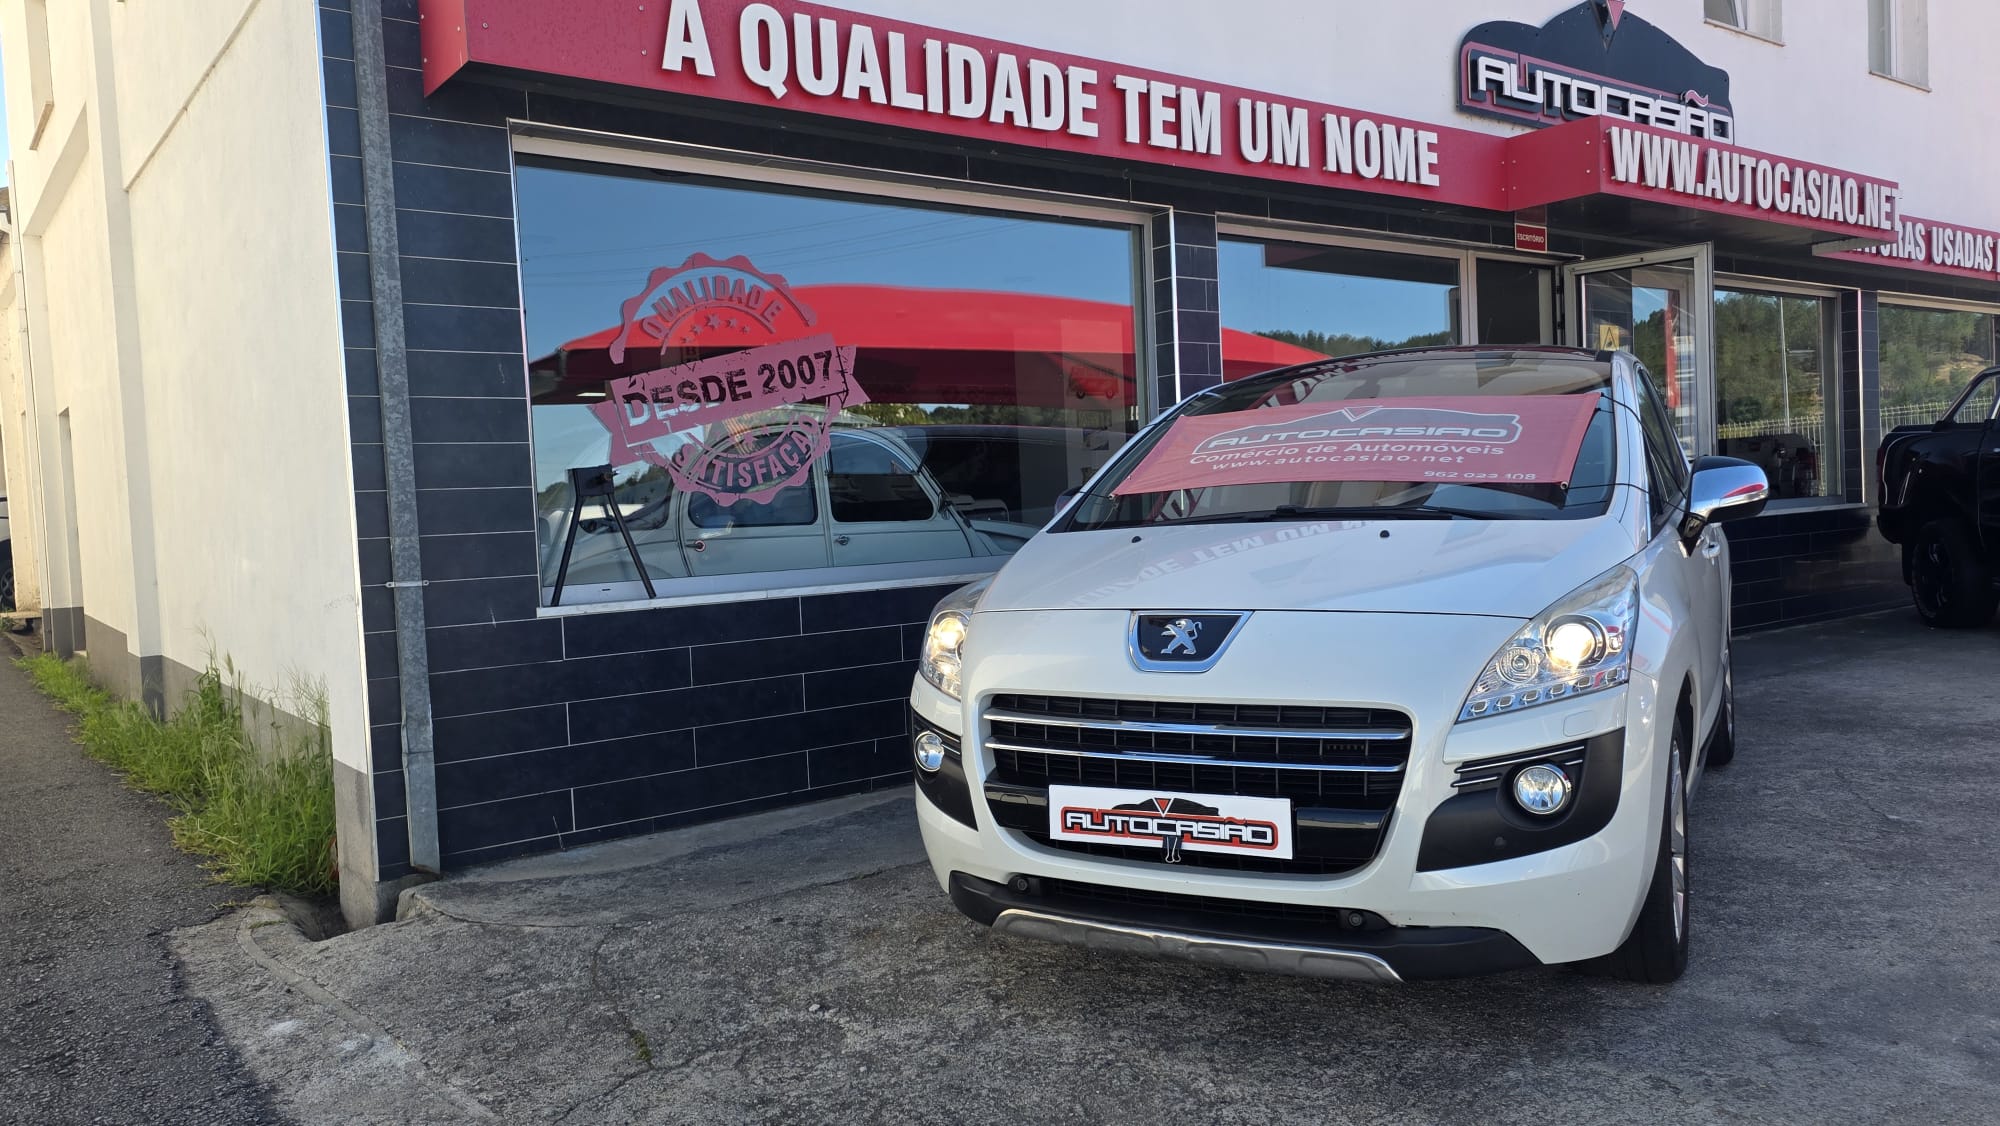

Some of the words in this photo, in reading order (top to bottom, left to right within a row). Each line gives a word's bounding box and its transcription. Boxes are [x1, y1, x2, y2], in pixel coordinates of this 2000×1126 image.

[661, 0, 715, 76] A
[740, 2, 1098, 138] QUALIDADE
[1116, 75, 1222, 156] TEM
[1238, 98, 1309, 168] UM
[1324, 113, 1440, 187] NOME
[1609, 126, 1902, 232] WWW.AUTOCASIAO.NET
[1931, 226, 1993, 272] USADAS
[622, 368, 753, 427] DESDE
[757, 350, 833, 396] 2007
[1190, 445, 1304, 465] Comércio
[1307, 444, 1337, 454] de
[1343, 442, 1505, 455] Automóveis
[1212, 453, 1465, 471] www.autocasiao.net
